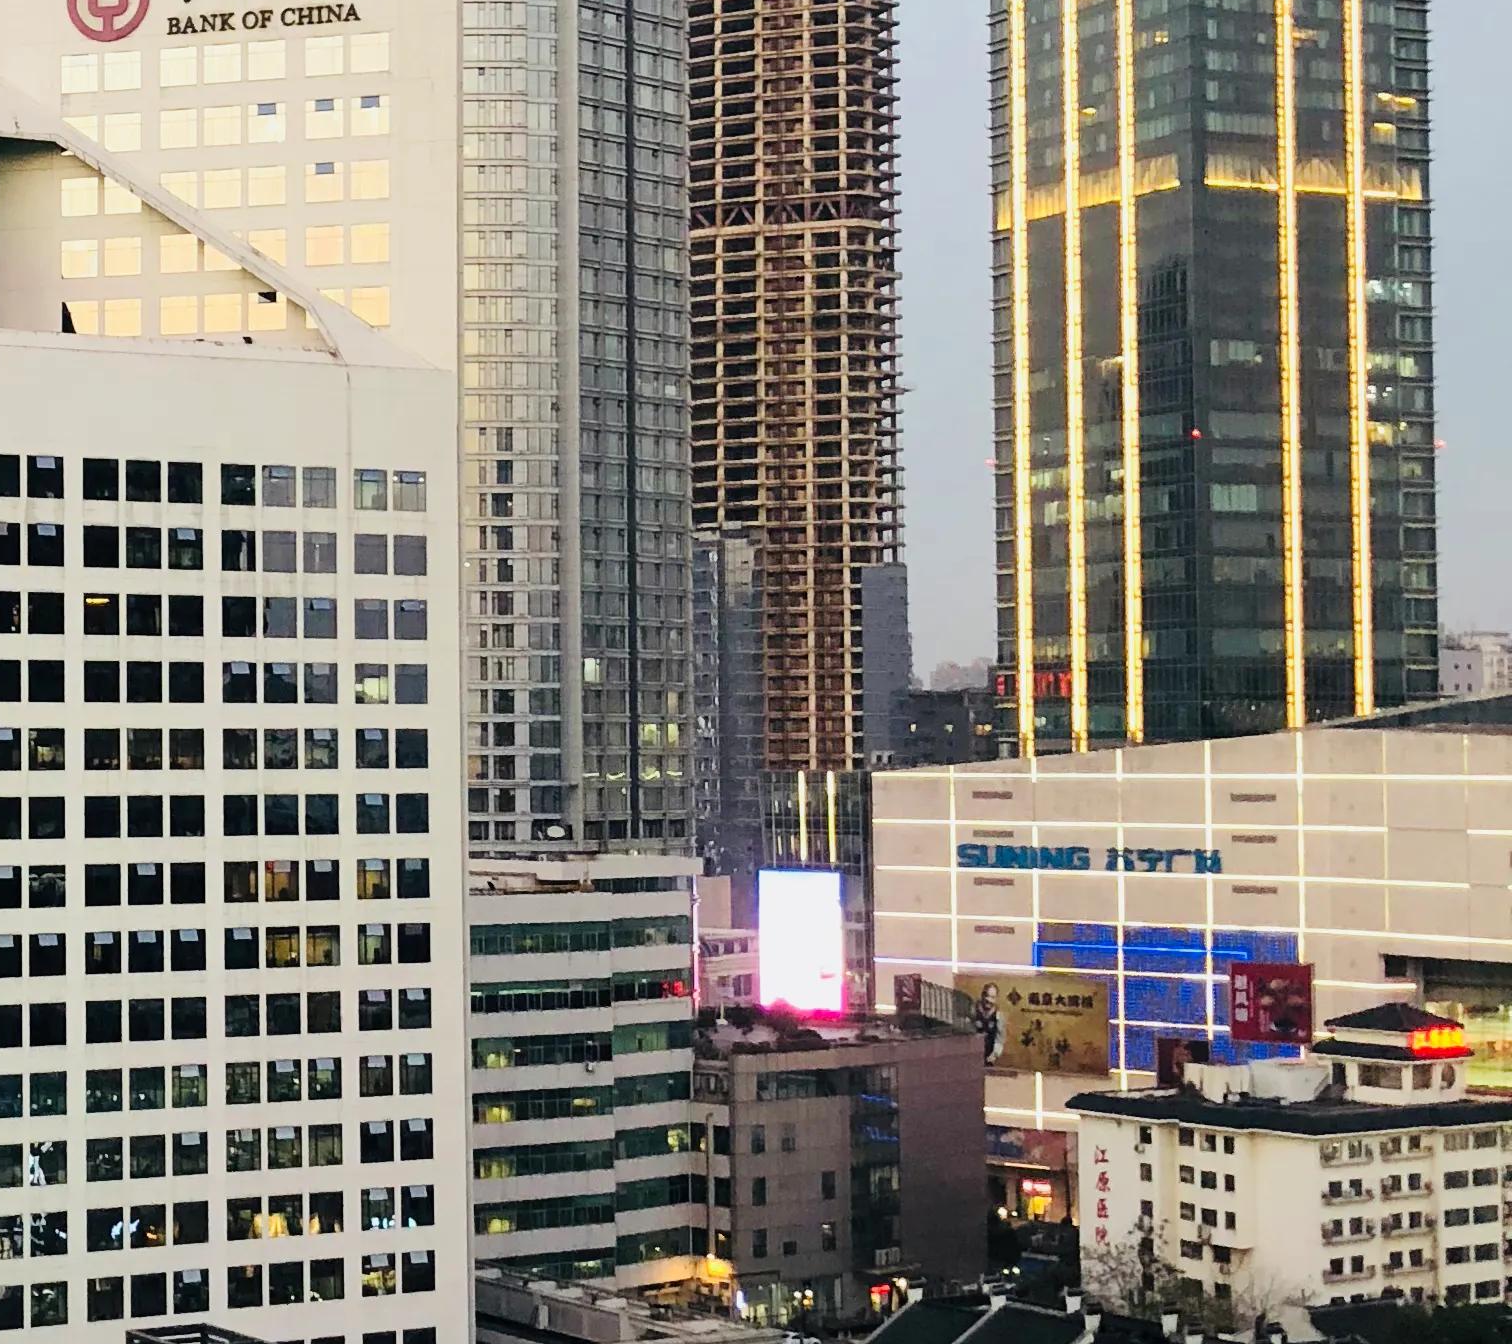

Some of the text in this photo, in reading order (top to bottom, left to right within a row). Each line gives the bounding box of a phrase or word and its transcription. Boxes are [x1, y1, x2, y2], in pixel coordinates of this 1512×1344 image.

[167, 3, 361, 35] BANK OF CHINA
[957, 843, 1091, 870] SUNING
[1094, 1144, 1111, 1246] 江原医院
